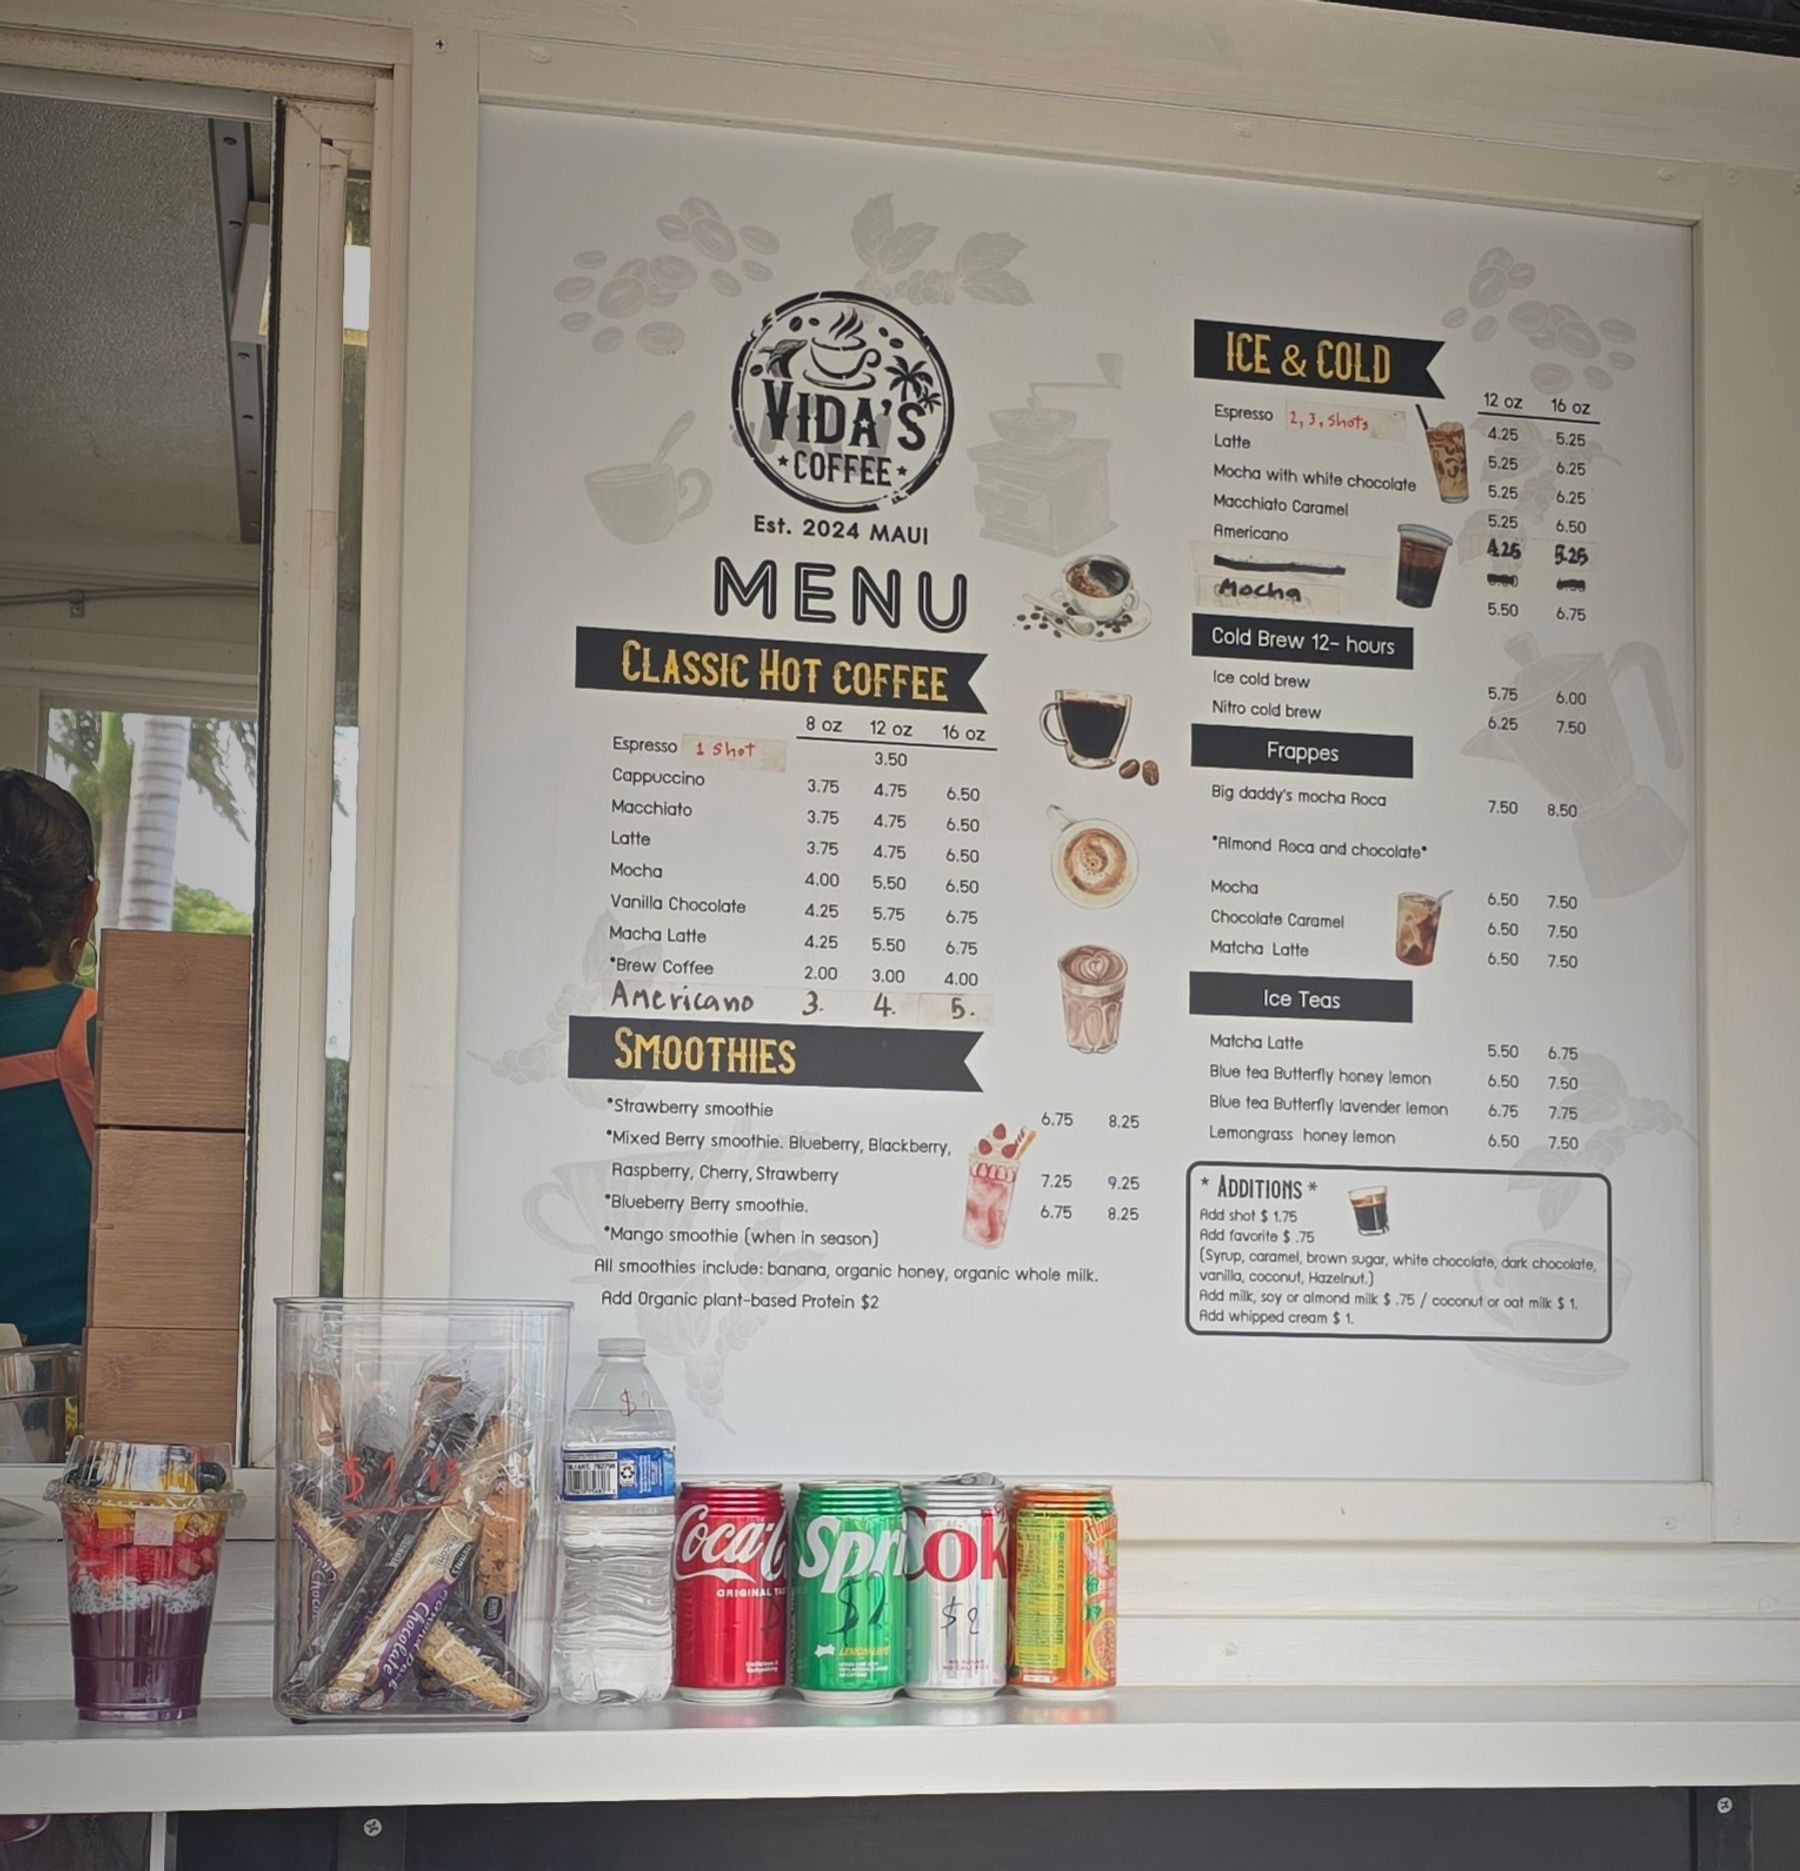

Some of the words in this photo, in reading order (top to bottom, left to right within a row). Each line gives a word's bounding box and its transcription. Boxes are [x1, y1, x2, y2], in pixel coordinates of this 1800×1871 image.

[1227, 331, 1271, 374] ICE
[1281, 344, 1306, 377] &
[1317, 340, 1390, 384] COLD
[761, 378, 927, 451] VIDA'S
[1215, 404, 1273, 421] Espresso
[794, 450, 892, 487] COFFEE
[1489, 456, 1518, 470] 5.25
[1556, 461, 1586, 476] 6.25
[1214, 464, 1261, 480] Mocha
[1266, 468, 1297, 482] with
[1303, 471, 1343, 486] white
[1347, 474, 1416, 492] chocolate
[1214, 493, 1287, 511] Macchiato
[1292, 500, 1348, 516] Caramel
[754, 515, 791, 534] Est.
[803, 519, 859, 539] 2024
[870, 524, 928, 545] MAUI
[1214, 524, 1288, 541] Americano
[714, 556, 967, 633] MENU
[1218, 578, 1301, 603] Mocha
[1212, 627, 1251, 645] Cold
[1259, 630, 1305, 649] Brew
[1347, 635, 1394, 655] hours
[622, 640, 749, 688] CLASSIC
[760, 648, 822, 693] HOT
[833, 661, 948, 701] COFFEE
[1214, 670, 1234, 684] Ice
[1240, 672, 1269, 686] cold
[1275, 673, 1310, 688] brew
[806, 716, 815, 731] 8
[822, 720, 842, 732] oz
[870, 720, 886, 735] 12
[893, 725, 912, 737] oz
[943, 725, 959, 739] 16
[966, 729, 985, 741] oz
[613, 736, 677, 754] Espresso
[1268, 741, 1338, 764] Frappes
[875, 752, 907, 766] 3.50
[613, 767, 705, 786] Cappuccino
[808, 779, 839, 793] 3.75
[874, 783, 907, 797] 4.75
[947, 787, 980, 801] 6.50
[1212, 784, 1234, 801] Big
[1239, 786, 1292, 804] daddy's
[1298, 791, 1345, 804] mocha
[1351, 792, 1386, 806] Roca
[612, 799, 692, 816] Macchiato
[612, 831, 650, 846] Latte
[1279, 839, 1314, 853] Roca
[1319, 842, 1346, 855] and
[611, 862, 662, 878] Mocha
[805, 872, 839, 887] 4.00
[873, 875, 906, 890] 5.50
[946, 880, 979, 894] 6.50
[611, 894, 662, 910] Vanilla
[669, 897, 746, 913] Chocolate
[805, 904, 839, 918] 4.25
[873, 907, 905, 921] 5.75
[946, 910, 978, 924] 6.75
[663, 960, 714, 975] Coffee
[805, 966, 837, 980] 2.00
[872, 969, 905, 983] 3.00
[944, 972, 978, 986] 4.00
[611, 980, 754, 1012] Americano
[1265, 989, 1291, 1006] Ice
[1299, 991, 1340, 1008] Teas
[615, 1027, 796, 1074] SMOOTHIES
[1210, 1034, 1262, 1048] Matcha
[1268, 1036, 1303, 1050] Latte
[1210, 1064, 1240, 1078] Blue
[1246, 1065, 1268, 1079] tea
[1274, 1066, 1334, 1085] Butterfly
[1339, 1068, 1383, 1086] honey
[1389, 1071, 1431, 1085] lemon
[705, 1102, 773, 1117] smoothie
[1041, 1112, 1073, 1126] 6.75
[1109, 1114, 1139, 1128] 8.25
[666, 1132, 705, 1150] Berry
[711, 1134, 783, 1149] smoothie.
[789, 1135, 863, 1154] Blueberry,
[869, 1138, 950, 1157] Blackberry,
[1210, 1125, 1293, 1143] Lemongrass
[1303, 1128, 1348, 1146] honey
[1353, 1129, 1395, 1144] lemon
[612, 1162, 693, 1181] Raspberry,
[700, 1164, 752, 1183] Cherry,
[756, 1166, 838, 1185] Strawberry
[1218, 1174, 1302, 1199] ADDITIONS
[1200, 1208, 1224, 1221] Add
[1229, 1209, 1255, 1221] shot
[1261, 1209, 1268, 1223] $
[1274, 1210, 1297, 1223] 1.75
[669, 1228, 738, 1242] smoothie
[745, 1227, 795, 1246] (when
[801, 1230, 814, 1244] in
[821, 1230, 878, 1248] season)
[1200, 1246, 1244, 1264] (Syrup,
[1249, 1251, 1302, 1265] caramel,
[1307, 1251, 1347, 1264] brown
[1352, 1255, 1388, 1268] sugar,
[1393, 1254, 1428, 1266] white
[1433, 1255, 1497, 1270] chocolate,
[1501, 1256, 1527, 1269] dark
[1532, 1258, 1596, 1272] chocolate,
[595, 1258, 612, 1272] All
[619, 1259, 695, 1273] smoothies
[703, 1260, 763, 1275] include:
[768, 1261, 829, 1279] banana,
[835, 1264, 892, 1280] organic
[898, 1264, 948, 1282] honey,
[954, 1266, 1009, 1283] organic
[1015, 1267, 1060, 1281] whole
[1067, 1268, 1098, 1282] milk.
[1199, 1269, 1244, 1284] vanilla,
[1249, 1271, 1304, 1285] coconut,
[1309, 1271, 1374, 1287] Hazelnut.)
[602, 1291, 632, 1305] Add
[638, 1291, 697, 1309] Organic
[802, 1294, 854, 1308] Protein
[861, 1294, 879, 1310] $2
[716, 1587, 772, 1598] ORIGINAL
[383, 1602, 430, 1676] Chocolate
